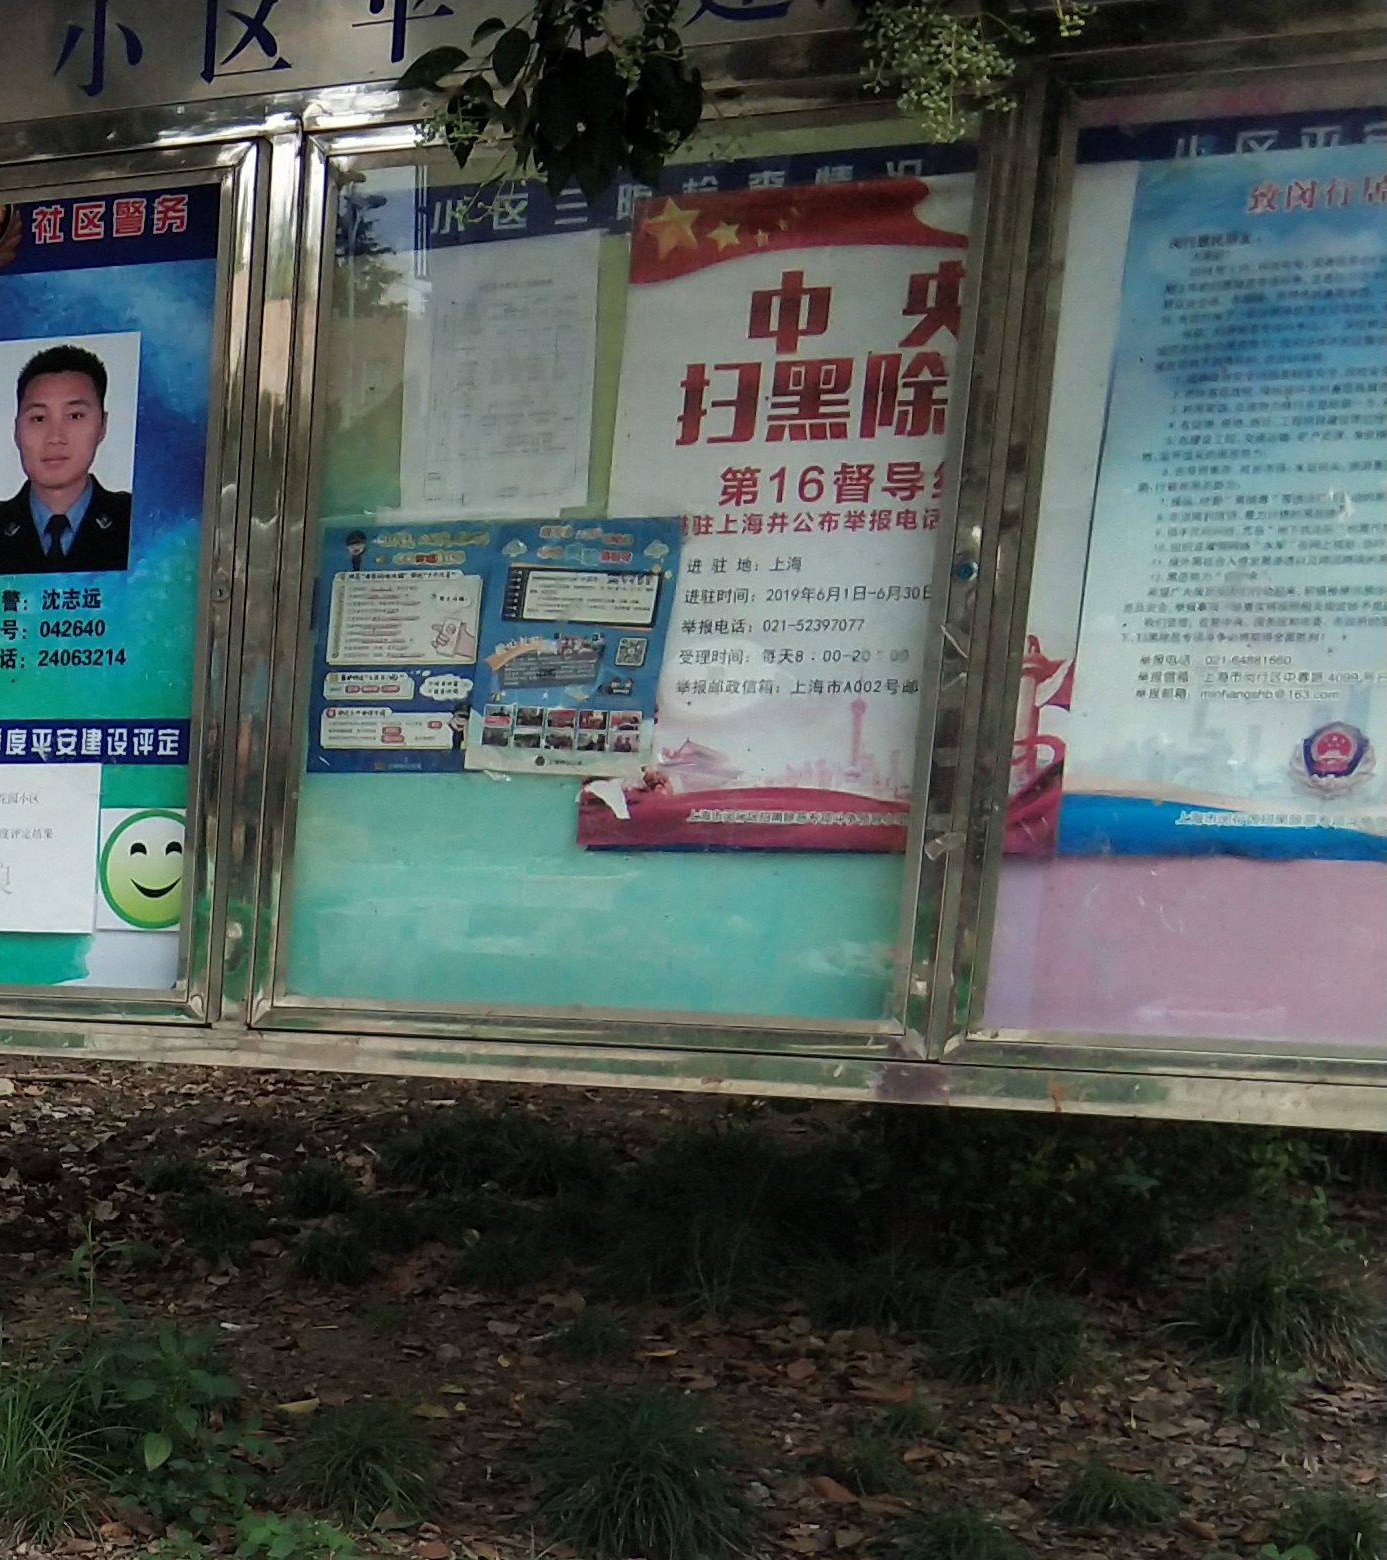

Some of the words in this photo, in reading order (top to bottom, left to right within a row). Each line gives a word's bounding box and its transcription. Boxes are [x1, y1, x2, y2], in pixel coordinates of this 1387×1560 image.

[32, 194, 188, 245] 社区警务
[675, 351, 950, 447] 扫黑除
